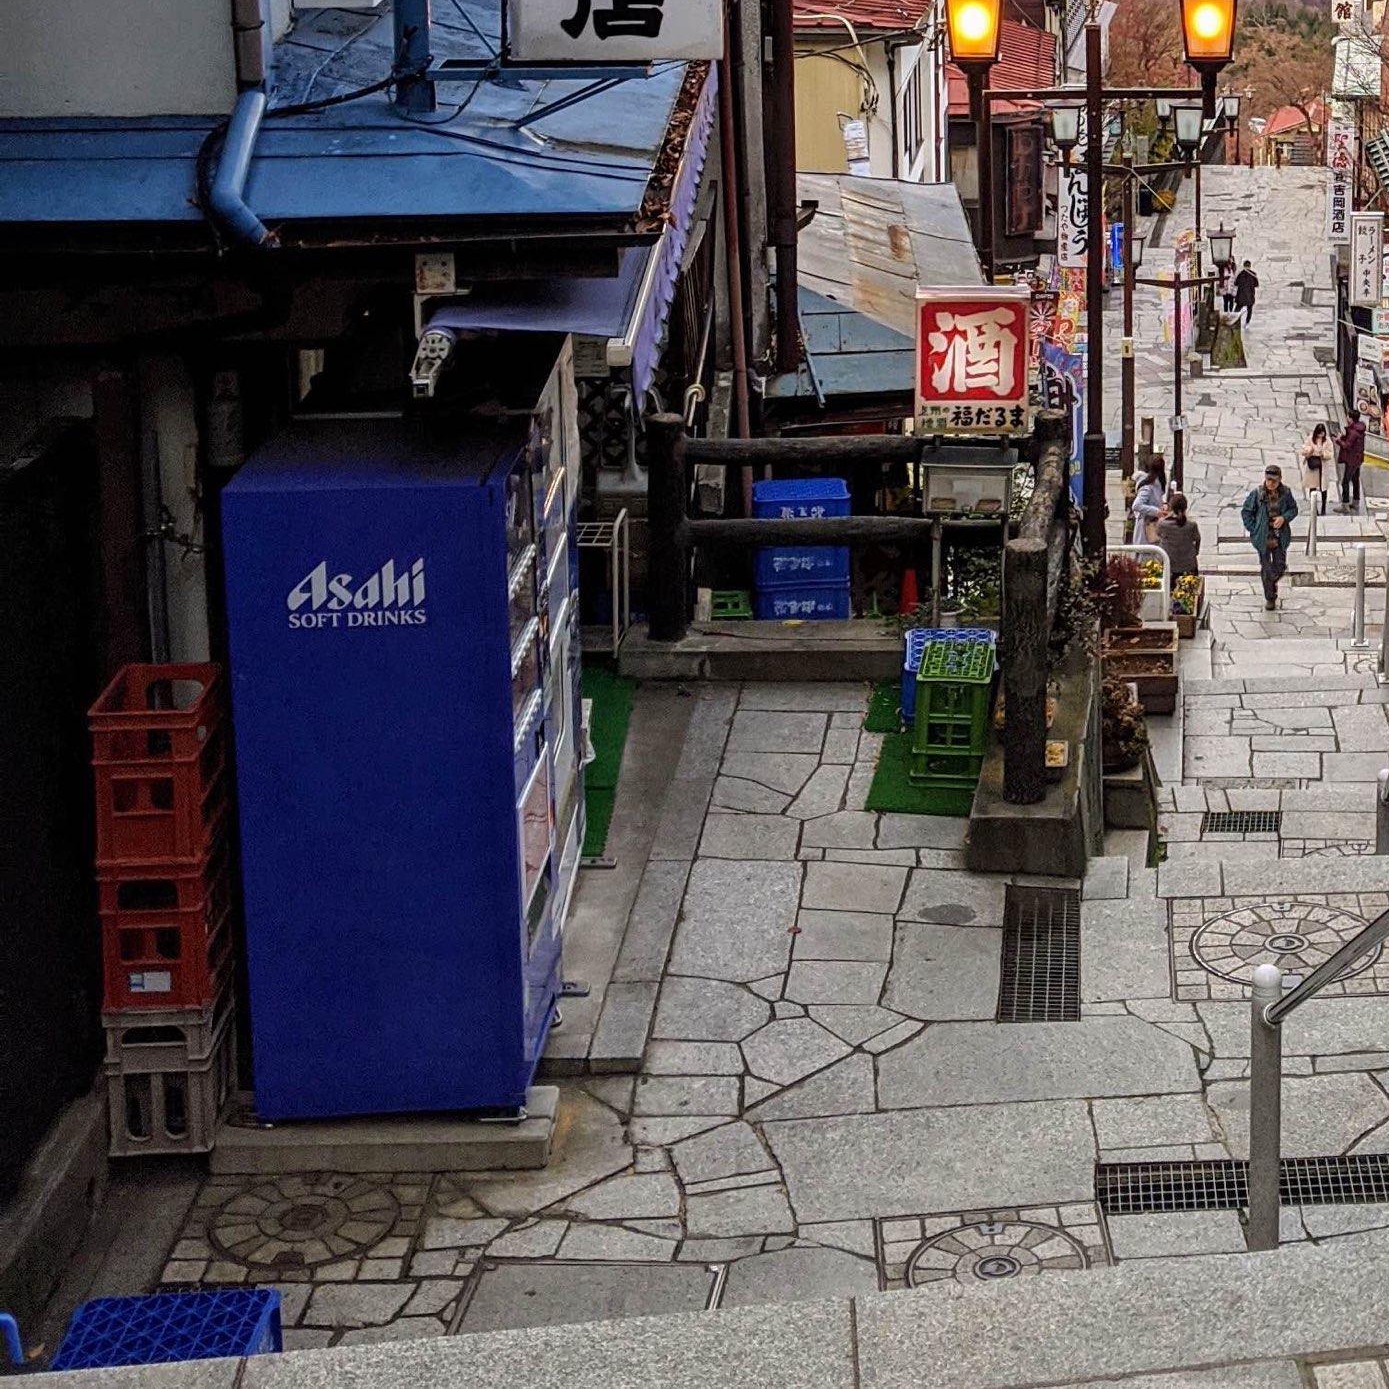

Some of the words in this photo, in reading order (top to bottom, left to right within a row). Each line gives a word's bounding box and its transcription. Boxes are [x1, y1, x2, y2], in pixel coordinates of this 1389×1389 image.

[929, 307, 1019, 396] 酒
[950, 405, 1026, 429] 福だるま
[287, 557, 426, 611] Asahi
[288, 612, 342, 629] SOFT
[347, 609, 427, 627] DRINKS
